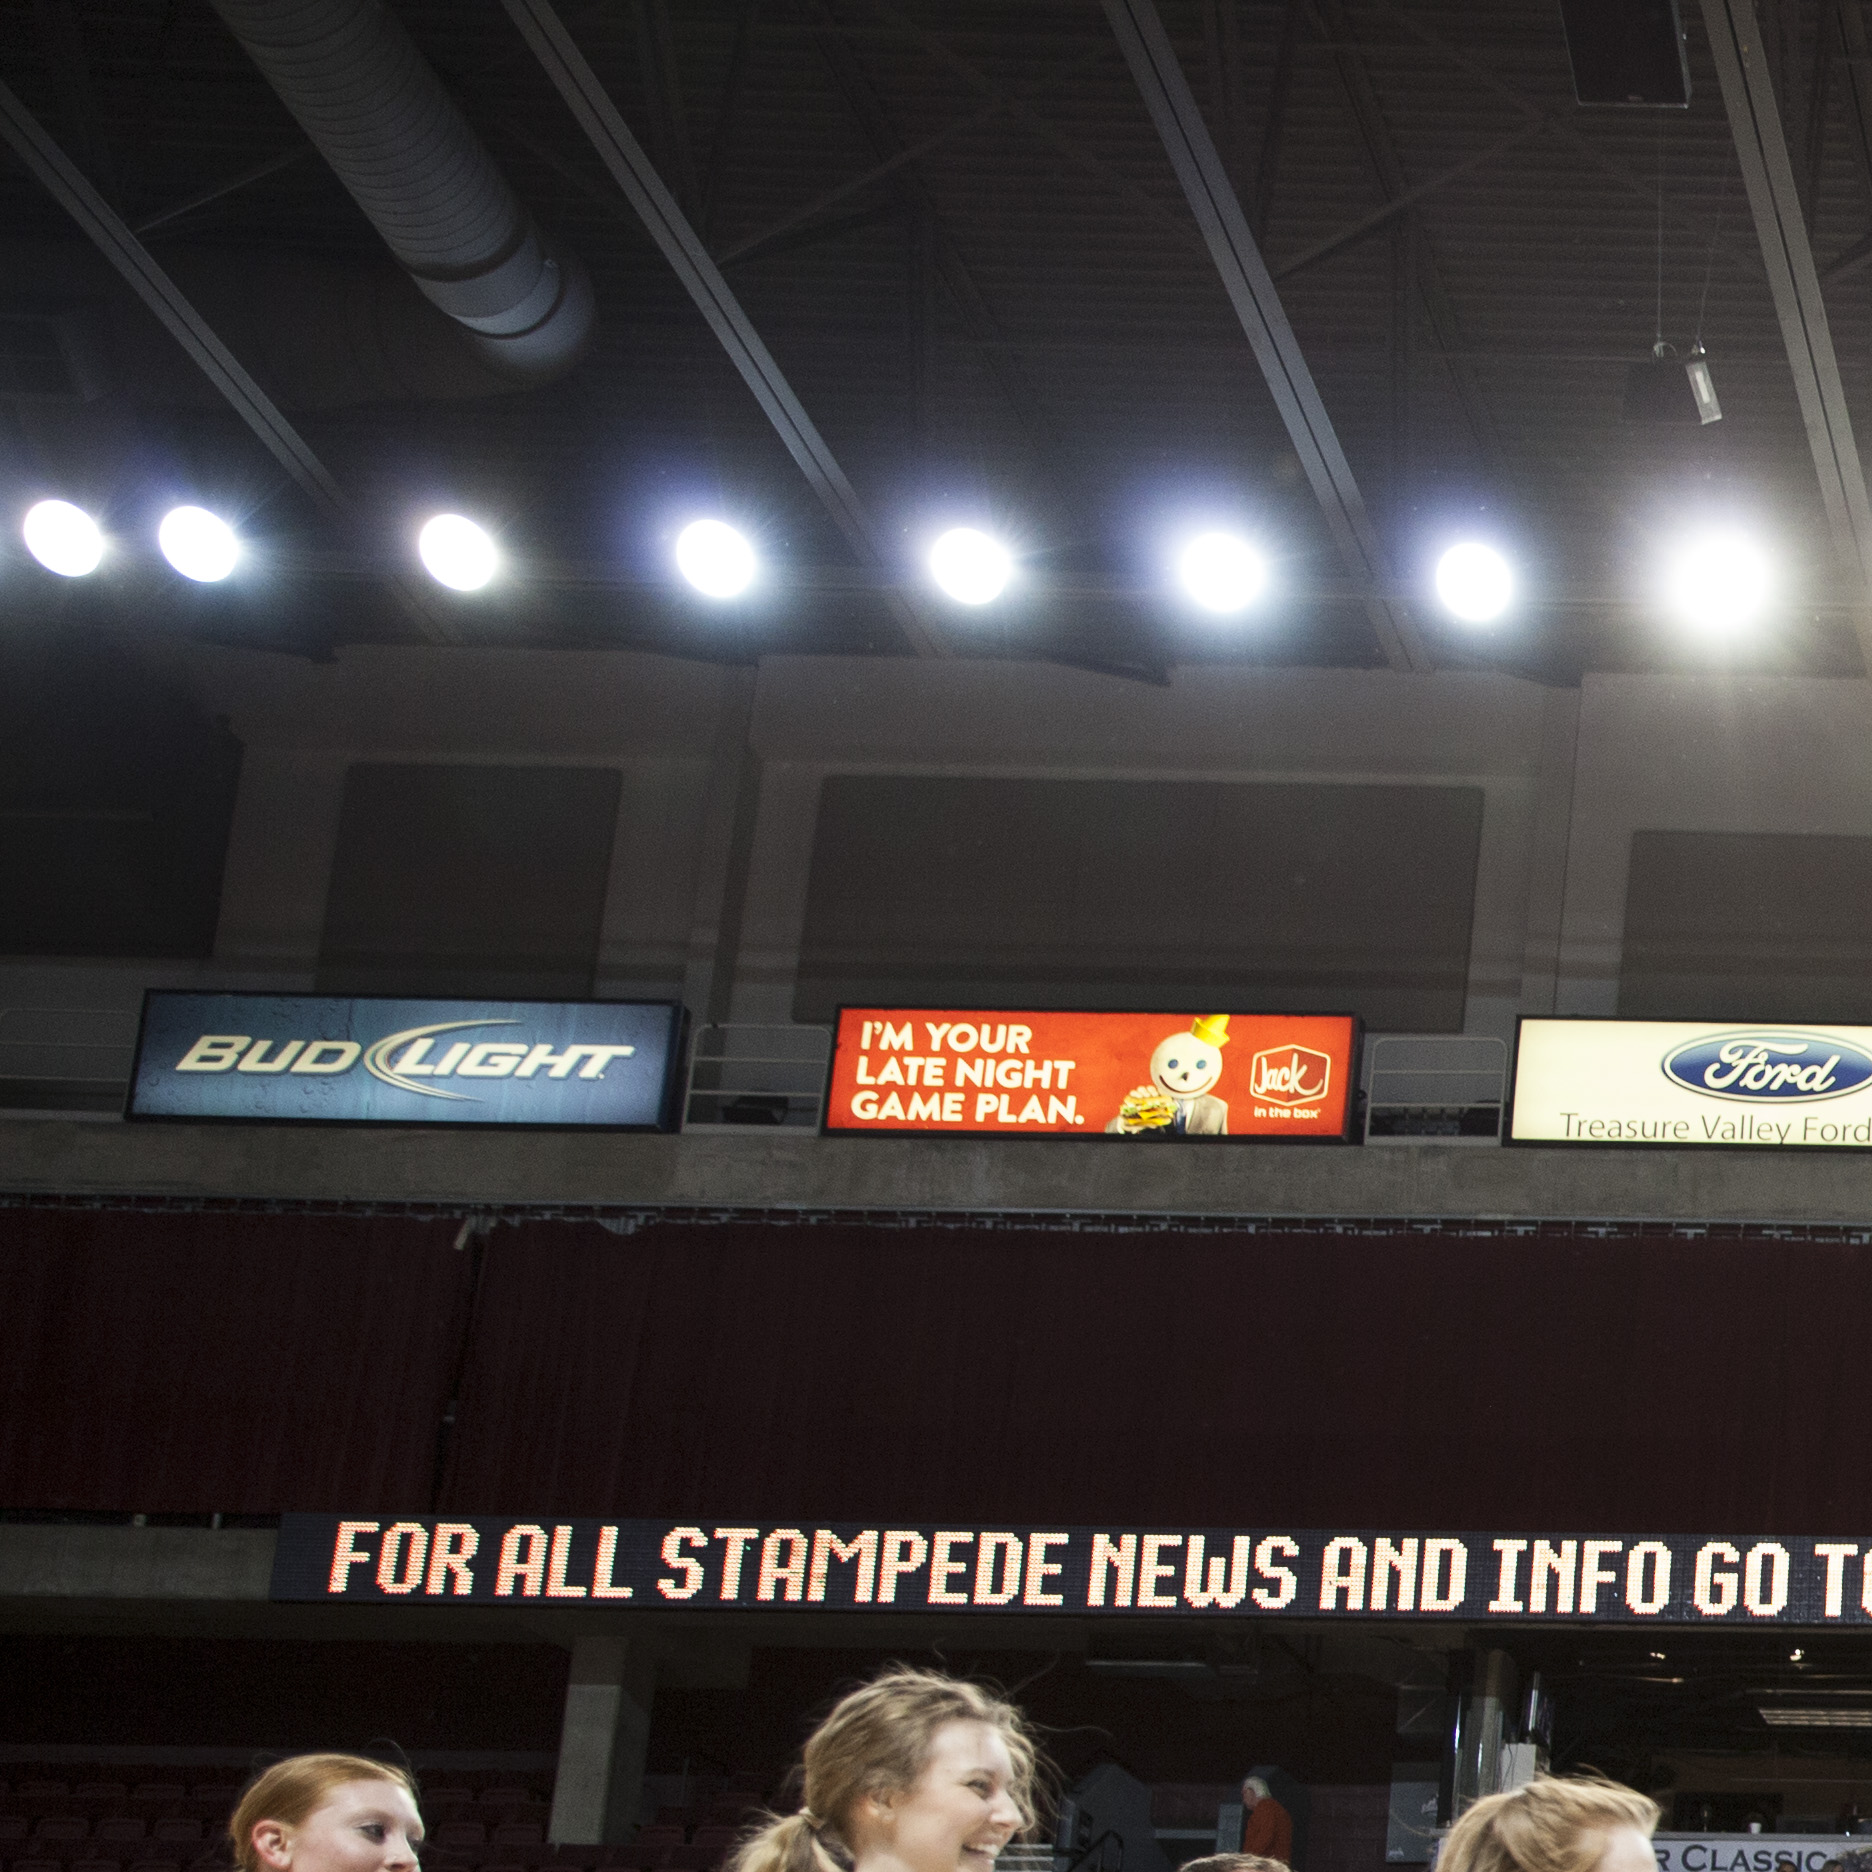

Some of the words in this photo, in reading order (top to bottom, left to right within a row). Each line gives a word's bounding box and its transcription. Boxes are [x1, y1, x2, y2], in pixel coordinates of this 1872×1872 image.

[924, 1022, 1034, 1055] YOUR
[175, 1034, 362, 1074] BUD
[392, 1037, 636, 1080] LIGHT
[855, 1056, 946, 1088] LATE
[954, 1059, 1077, 1091] NIGHT
[1254, 1053, 1326, 1097] Jack
[1703, 1038, 1842, 1093] Ford
[849, 1090, 965, 1123] GAME
[973, 1092, 1086, 1126] PLAN.
[1253, 1106, 1269, 1119] in
[1271, 1106, 1291, 1119] the
[1559, 1111, 1690, 1141] Treasure
[1701, 1114, 1799, 1146] Valley
[1803, 1115, 1872, 1144] Ford
[328, 1520, 481, 1597] FOR
[494, 1523, 634, 1600] ALL
[656, 1526, 1069, 1607] STAMPEDE
[1087, 1533, 1300, 1610] NEWS
[1318, 1536, 1469, 1613] AND
[1488, 1539, 1674, 1616] INFO
[1693, 1541, 1792, 1618] GO
